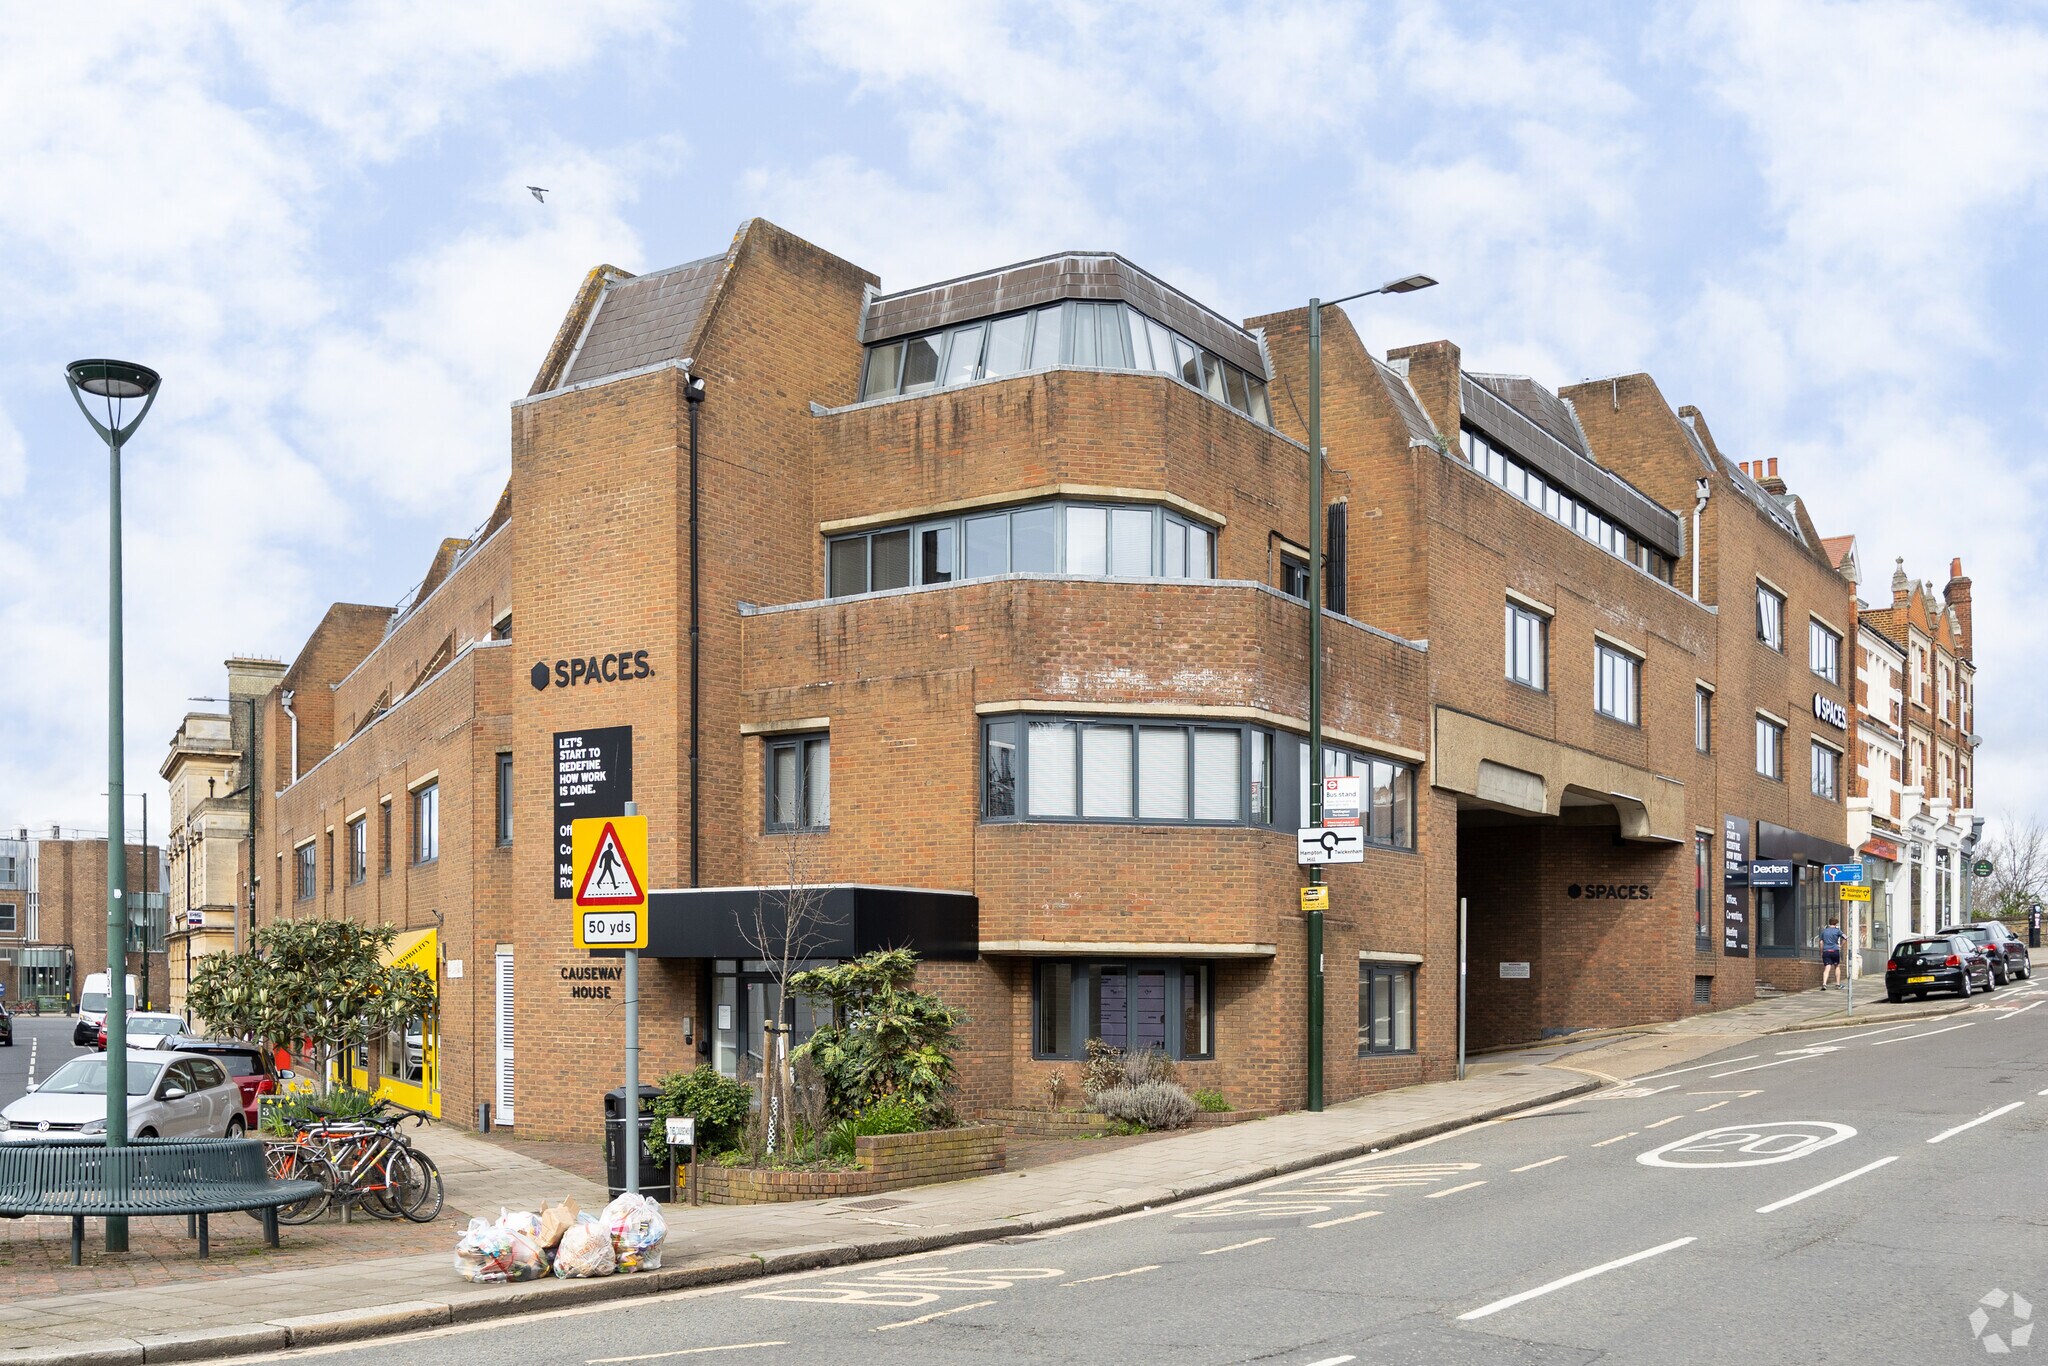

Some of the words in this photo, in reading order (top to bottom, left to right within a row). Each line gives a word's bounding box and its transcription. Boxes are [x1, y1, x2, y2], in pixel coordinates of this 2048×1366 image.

[555, 650, 655, 688] SPACES.
[559, 737, 583, 749] LET'S
[559, 748, 587, 761] START
[588, 747, 601, 759] TO
[559, 759, 601, 773] REDEFINE
[559, 772, 580, 785] HOW
[581, 771, 606, 783] WORK
[559, 785, 569, 797] IS
[569, 784, 597, 796] DONE.
[1753, 864, 1789, 874] Dexters
[1584, 884, 1653, 900] SPACES.
[589, 920, 605, 933] 50
[610, 920, 631, 936] yds
[397, 940, 430, 964] MOBILITY
[561, 967, 622, 980] CAUSEWAY
[572, 986, 612, 999] HOUSE
[262, 1107, 270, 1116] 3
[1672, 1133, 1820, 1154] 20
[1172, 1162, 1482, 1218] STAND
[739, 1267, 1066, 1307] BUS
